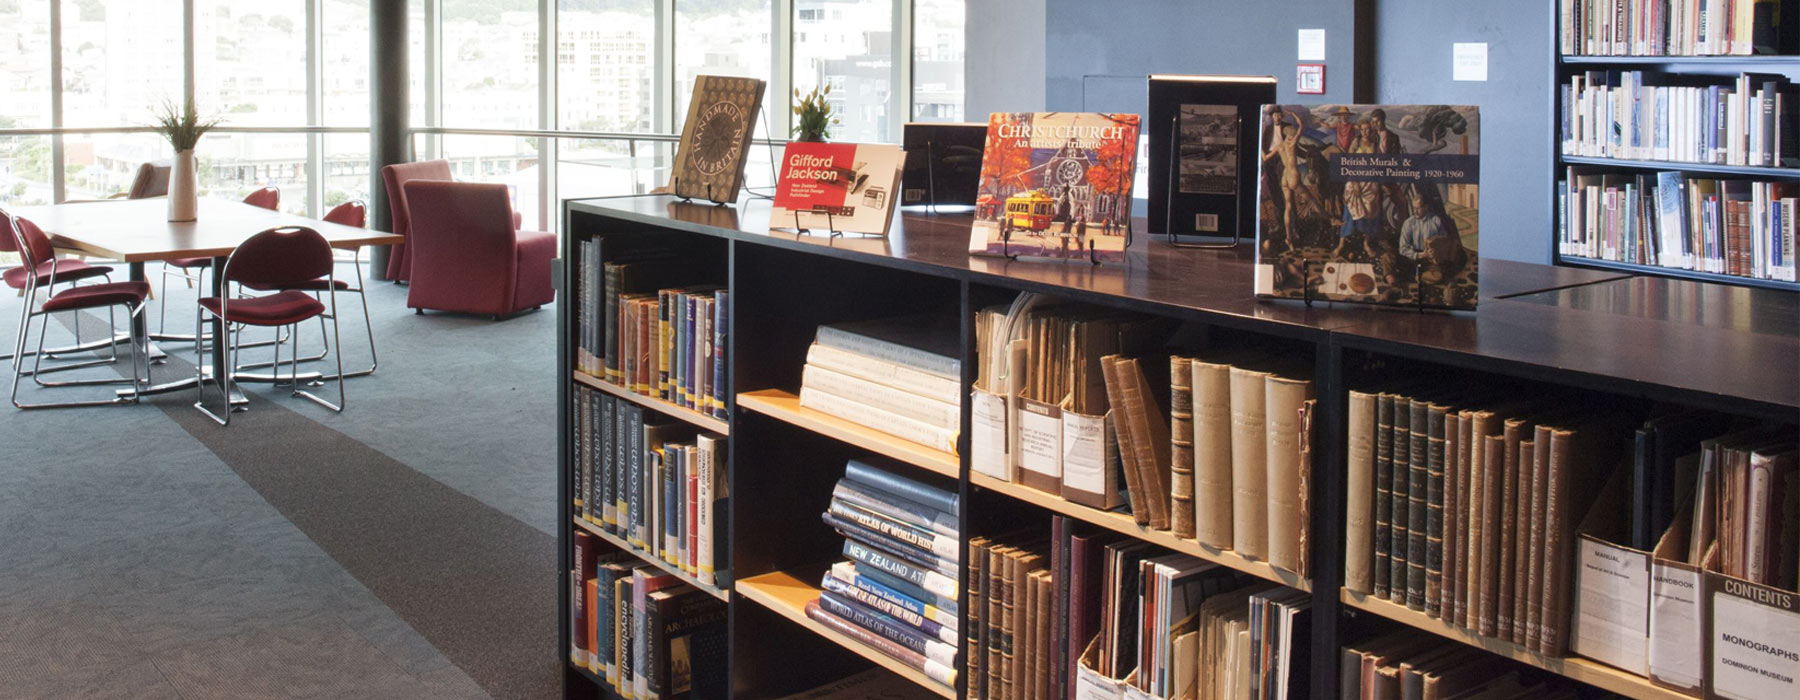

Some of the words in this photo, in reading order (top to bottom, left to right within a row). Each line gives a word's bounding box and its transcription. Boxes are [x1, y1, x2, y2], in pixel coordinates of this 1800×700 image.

[693, 102, 741, 153] HANDMADE
[998, 123, 1122, 140] CHRISTCHURCH
[697, 156, 709, 171] IN
[709, 129, 742, 172] BRITAIN
[1013, 139, 1028, 148] An
[1066, 140, 1102, 149] tribute
[790, 154, 834, 168] Gifford
[1340, 157, 1367, 167] British
[1369, 157, 1398, 167] Murals
[1402, 158, 1411, 167] &
[786, 166, 838, 181] Jackson
[1340, 168, 1383, 177] Decorative
[1385, 168, 1420, 179] Painting
[1423, 169, 1464, 179] 1920-1960
[857, 514, 881, 530] ATLAS
[879, 523, 891, 534] OF
[888, 526, 918, 544] WORLD
[917, 536, 934, 551] HIST
[848, 546, 868, 560] NEW
[869, 554, 909, 576] ZEALAND
[1594, 551, 1620, 564] MANUAL
[1653, 575, 1694, 589] HANDBOOK
[1725, 579, 1792, 609] CONTENTS
[828, 601, 854, 619] WORLD
[852, 612, 875, 628] ATLAS
[872, 621, 885, 633] OF
[883, 626, 900, 640] THE
[899, 608, 924, 627] WORLD
[1722, 632, 1799, 663] MONOGRAPHS
[1722, 657, 1759, 674] DOMINION
[1759, 668, 1793, 684] MUSEUM
